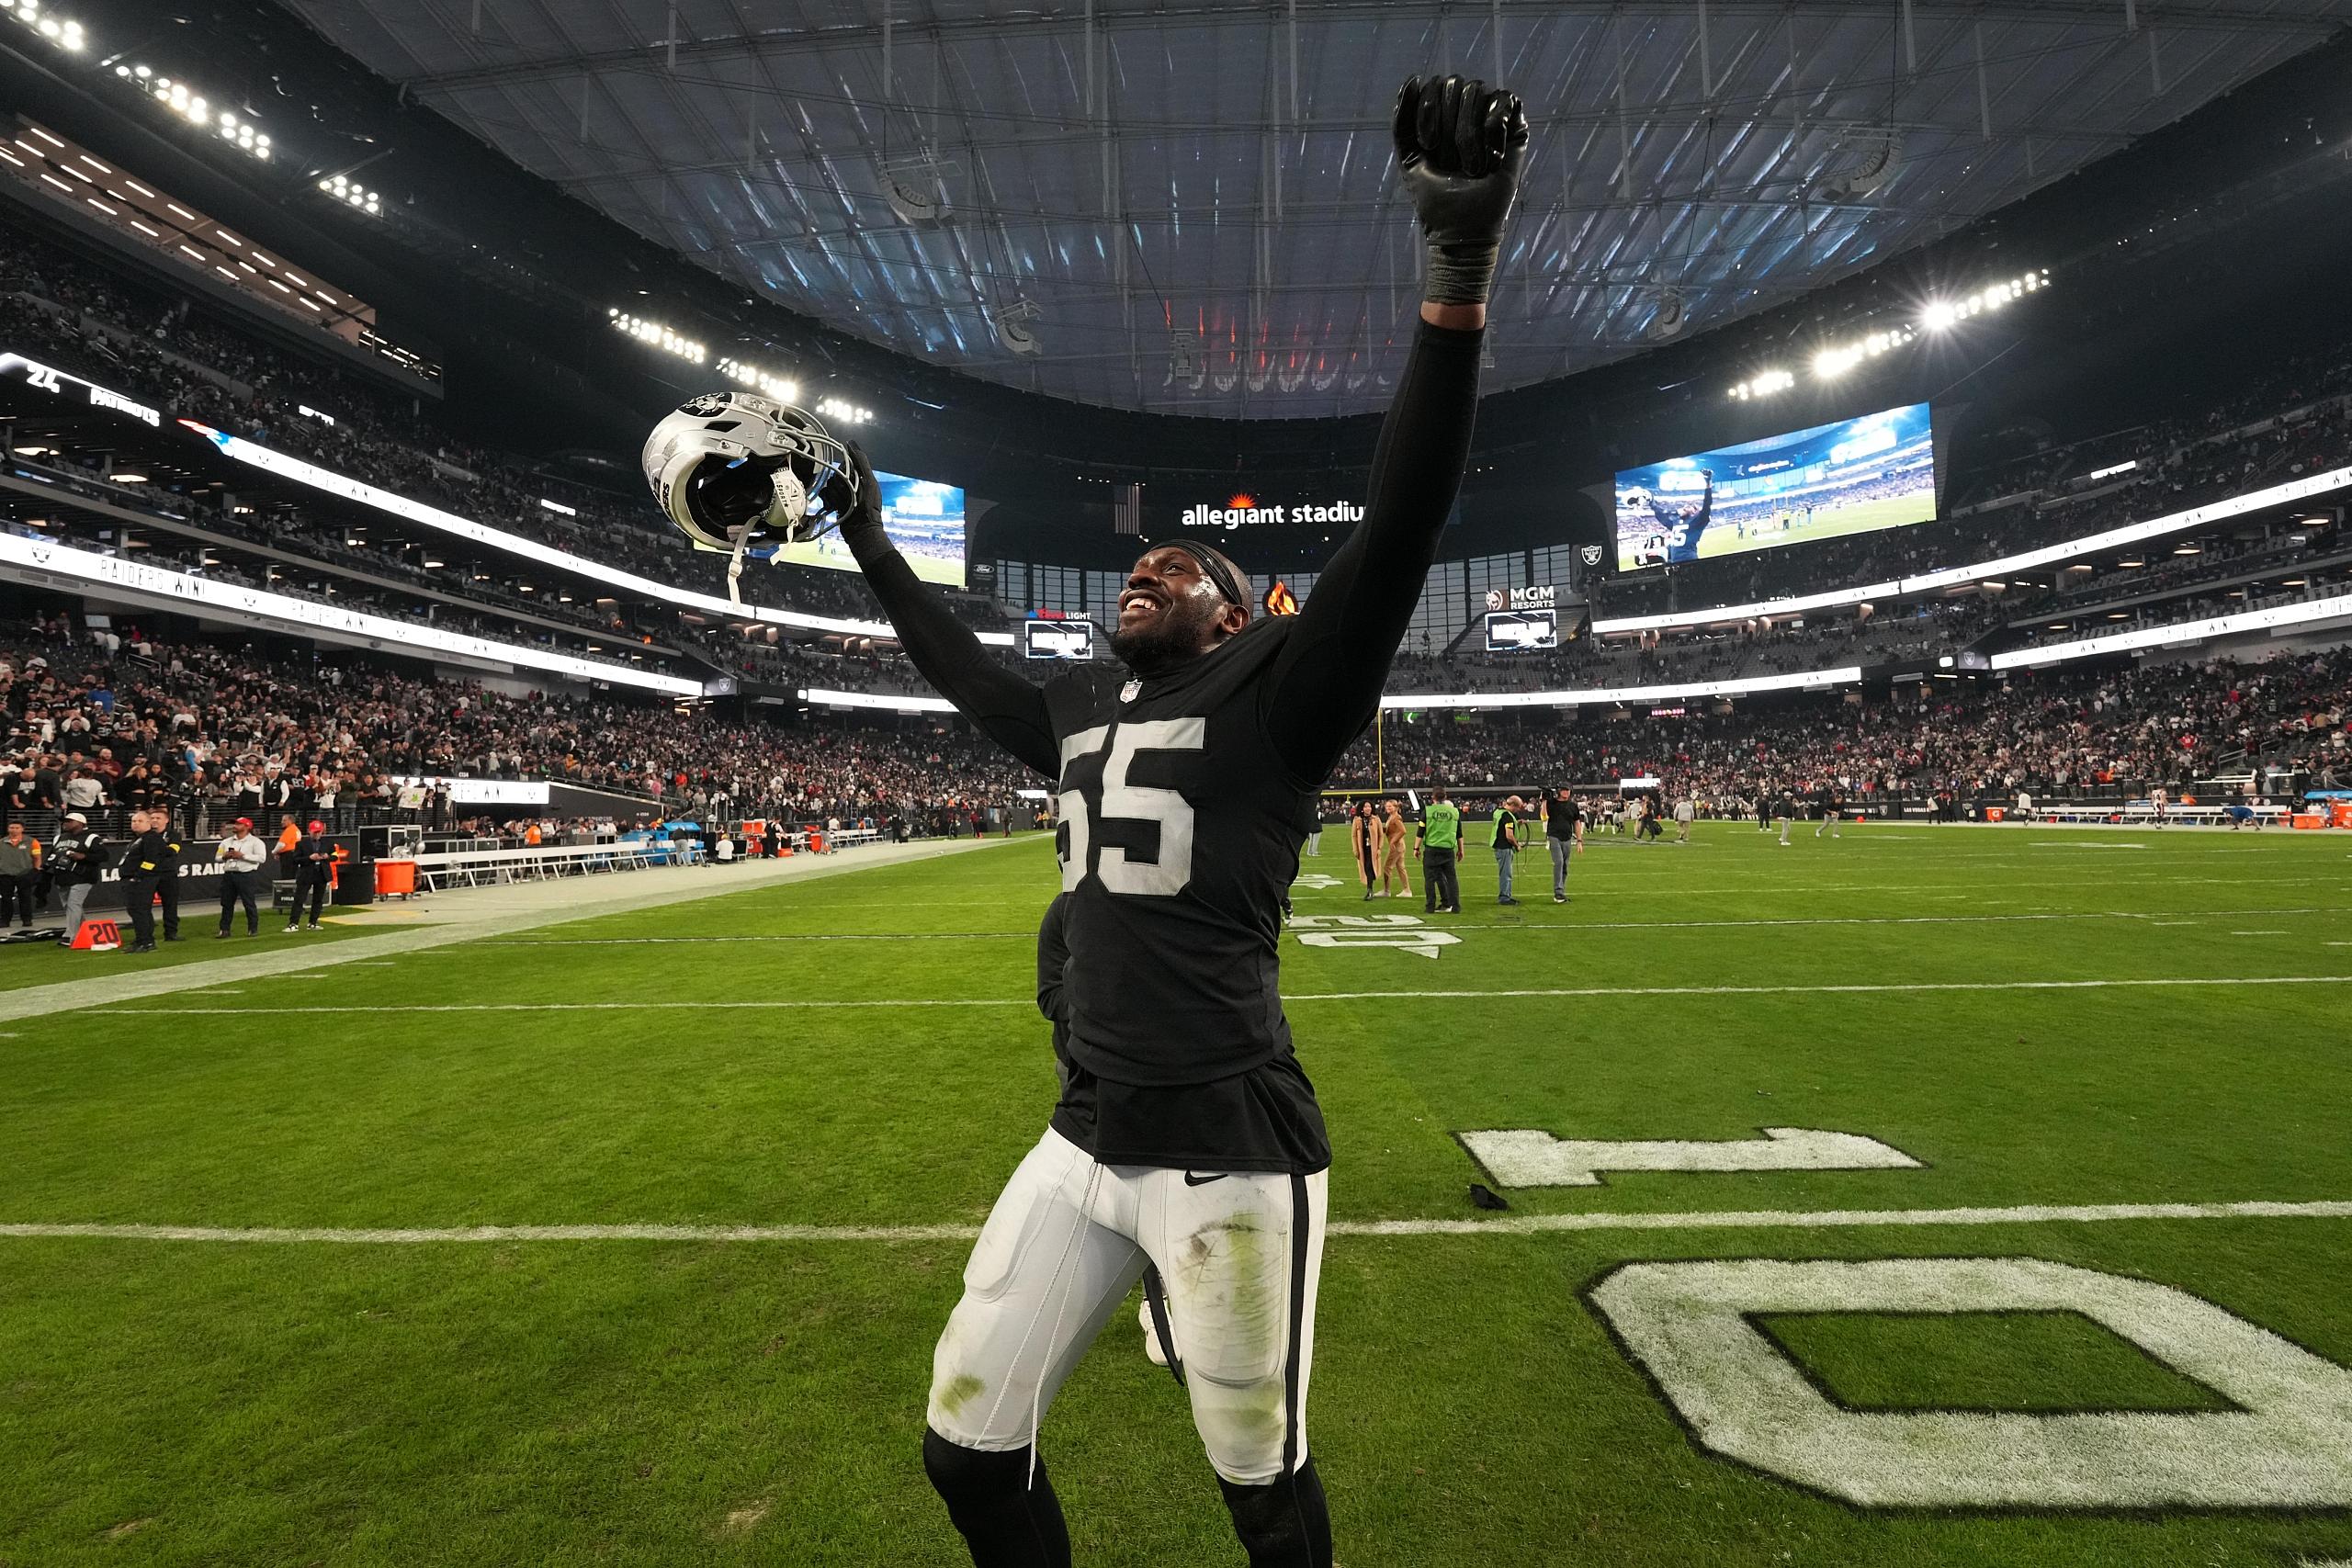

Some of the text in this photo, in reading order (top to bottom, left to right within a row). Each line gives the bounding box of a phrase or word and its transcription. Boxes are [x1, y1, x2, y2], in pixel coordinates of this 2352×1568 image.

[27, 364, 60, 393] 24
[90, 387, 160, 427] PATRIOTS
[1182, 501, 1367, 530] allegiant stadiu
[101, 559, 164, 589] RAIDERS
[1510, 585, 1555, 602] MGM
[1510, 600, 1555, 610] RESORTS
[1066, 612, 1091, 620] LIGHT
[1057, 716, 1205, 897] 55
[101, 868, 121, 882] LA
[88, 922, 119, 945] 20
